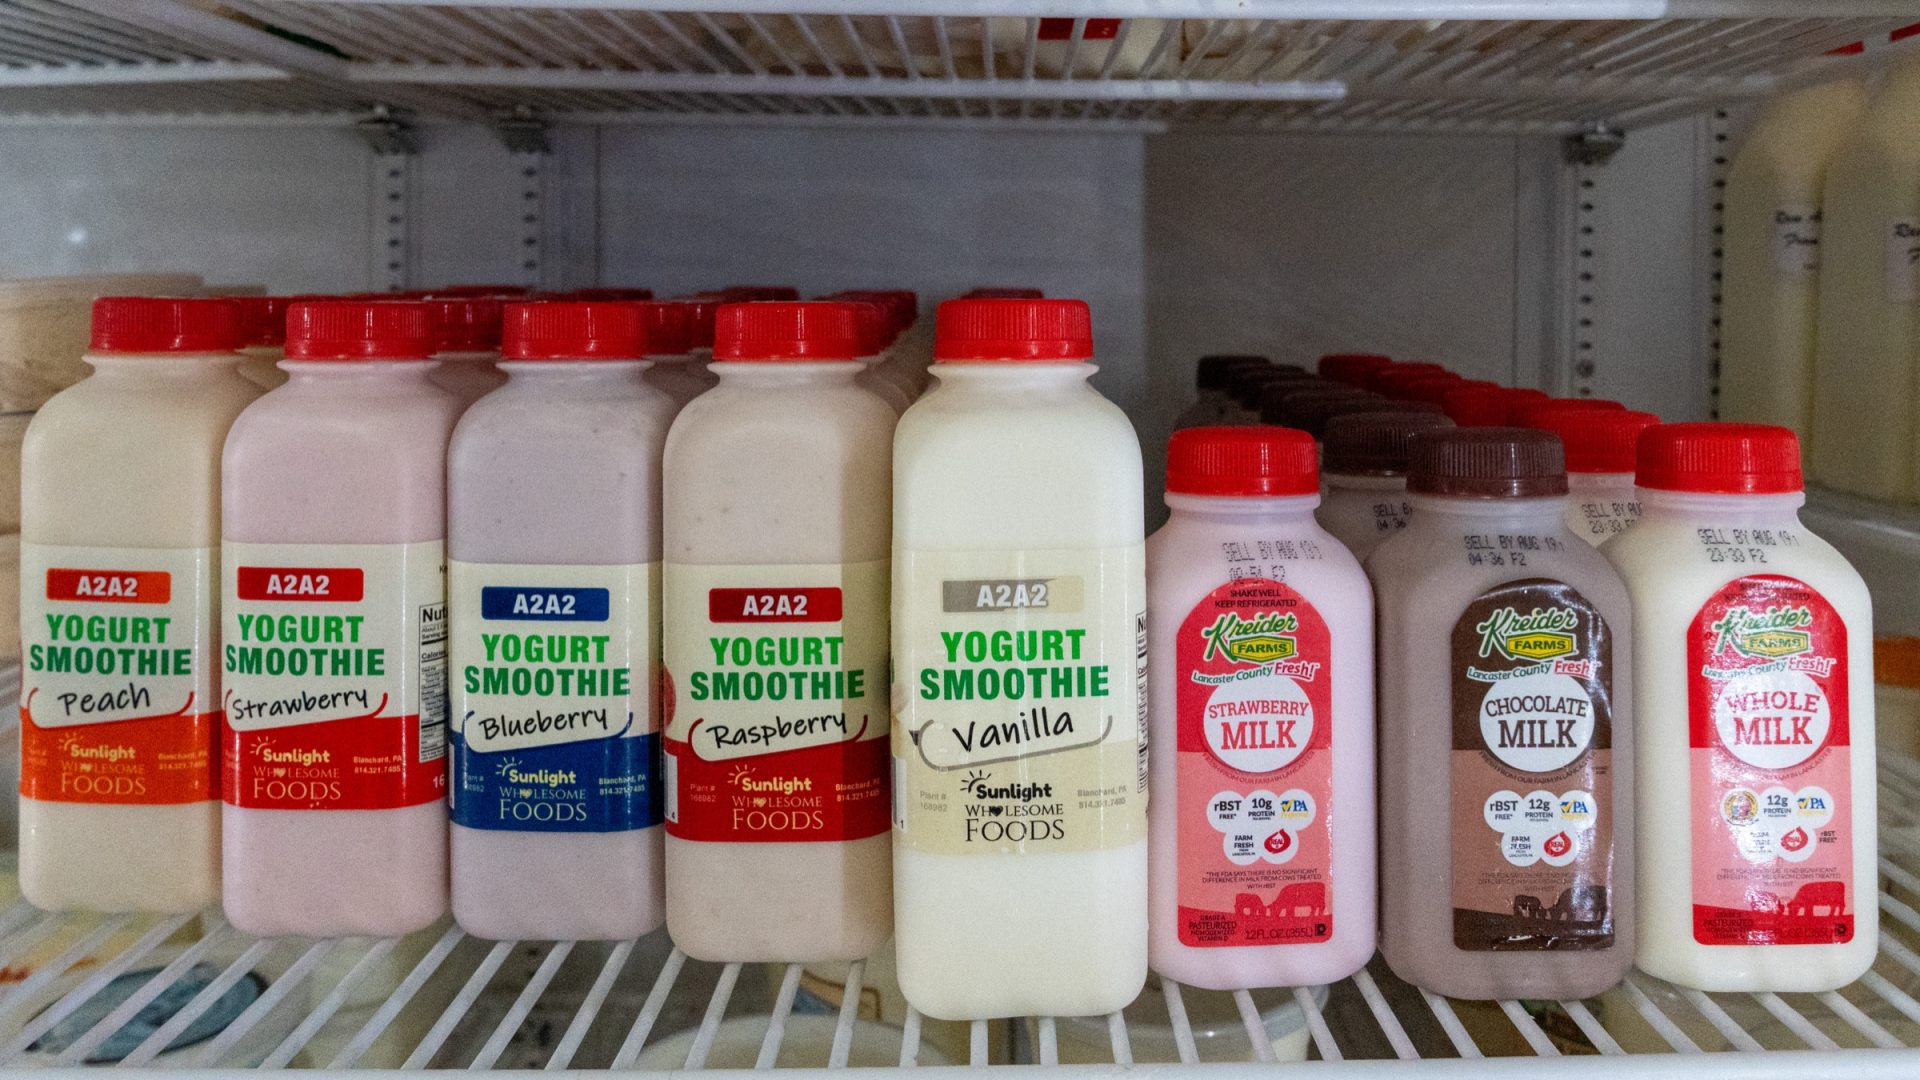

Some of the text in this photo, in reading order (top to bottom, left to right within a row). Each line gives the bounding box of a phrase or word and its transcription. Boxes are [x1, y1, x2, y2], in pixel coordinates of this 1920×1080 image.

[1464, 535, 1540, 549] SELL BY AUG
[1697, 529, 1776, 545] SELL BY AUG
[1511, 553, 1527, 565] F2
[1706, 547, 1767, 563] 23:33 F2
[76, 576, 138, 596] A2A2
[266, 575, 330, 594] A2A2
[1230, 590, 1259, 598] SHAKE
[513, 594, 576, 614] A2A2
[743, 595, 807, 616] A2A2
[976, 584, 1048, 608] A2A2
[1215, 599, 1296, 608] KEEP REFRIGERATED
[46, 614, 171, 643] YOGURT
[237, 613, 364, 643] YOGURT
[1204, 614, 1297, 662] Kreider
[1479, 610, 1576, 658] Kreider
[482, 634, 609, 663] YOGURT
[710, 636, 844, 666] YOGURT
[940, 629, 1086, 663] YOGURT
[1238, 643, 1287, 653] FARMS
[1514, 640, 1566, 649] FARMS
[1749, 639, 1800, 647] FARMS
[30, 645, 191, 676] SMOOTHIE
[226, 645, 384, 676] SMOOTHIE
[464, 665, 630, 696] SMOOTHIE
[1193, 672, 1235, 684] Lancaster
[1236, 667, 1273, 679] County
[1468, 668, 1511, 680] Lancaster
[1513, 663, 1551, 676] County
[690, 669, 865, 701] SMOOTHIE
[920, 666, 1109, 700] SMOOTHIE
[57, 682, 150, 716] Peach
[232, 689, 368, 720] Strawberry
[1208, 700, 1309, 718] STRAWBERRY
[1485, 695, 1588, 717] CHOCOLATE
[1726, 690, 1820, 713] WHOLE
[479, 709, 608, 740] Blueberry
[706, 713, 847, 748] Raspberry
[952, 707, 1074, 752] Vanilla
[1221, 720, 1296, 749] MILK
[1498, 720, 1577, 748] MILK
[1734, 716, 1813, 745] MILK
[71, 744, 136, 761] Sunlight
[263, 749, 330, 766] Sunlight
[61, 773, 146, 796] FOODS
[509, 769, 576, 787] Sunlight
[742, 777, 812, 795] Sunlight
[253, 778, 341, 800] FOODS
[976, 783, 1052, 802] Sunlight
[499, 799, 587, 821] FOODS
[1214, 801, 1241, 811] rBST
[1252, 798, 1272, 810] 10g
[1293, 800, 1307, 811] PA
[1490, 801, 1518, 811] rBST
[1529, 799, 1550, 811] 12g
[1573, 801, 1588, 813] PA
[1767, 795, 1788, 806] 12g
[1811, 797, 1825, 809] PA
[733, 808, 823, 830] FOODS
[965, 818, 1065, 842] FOODS
[1189, 921, 1237, 929] PASTEURIZED
